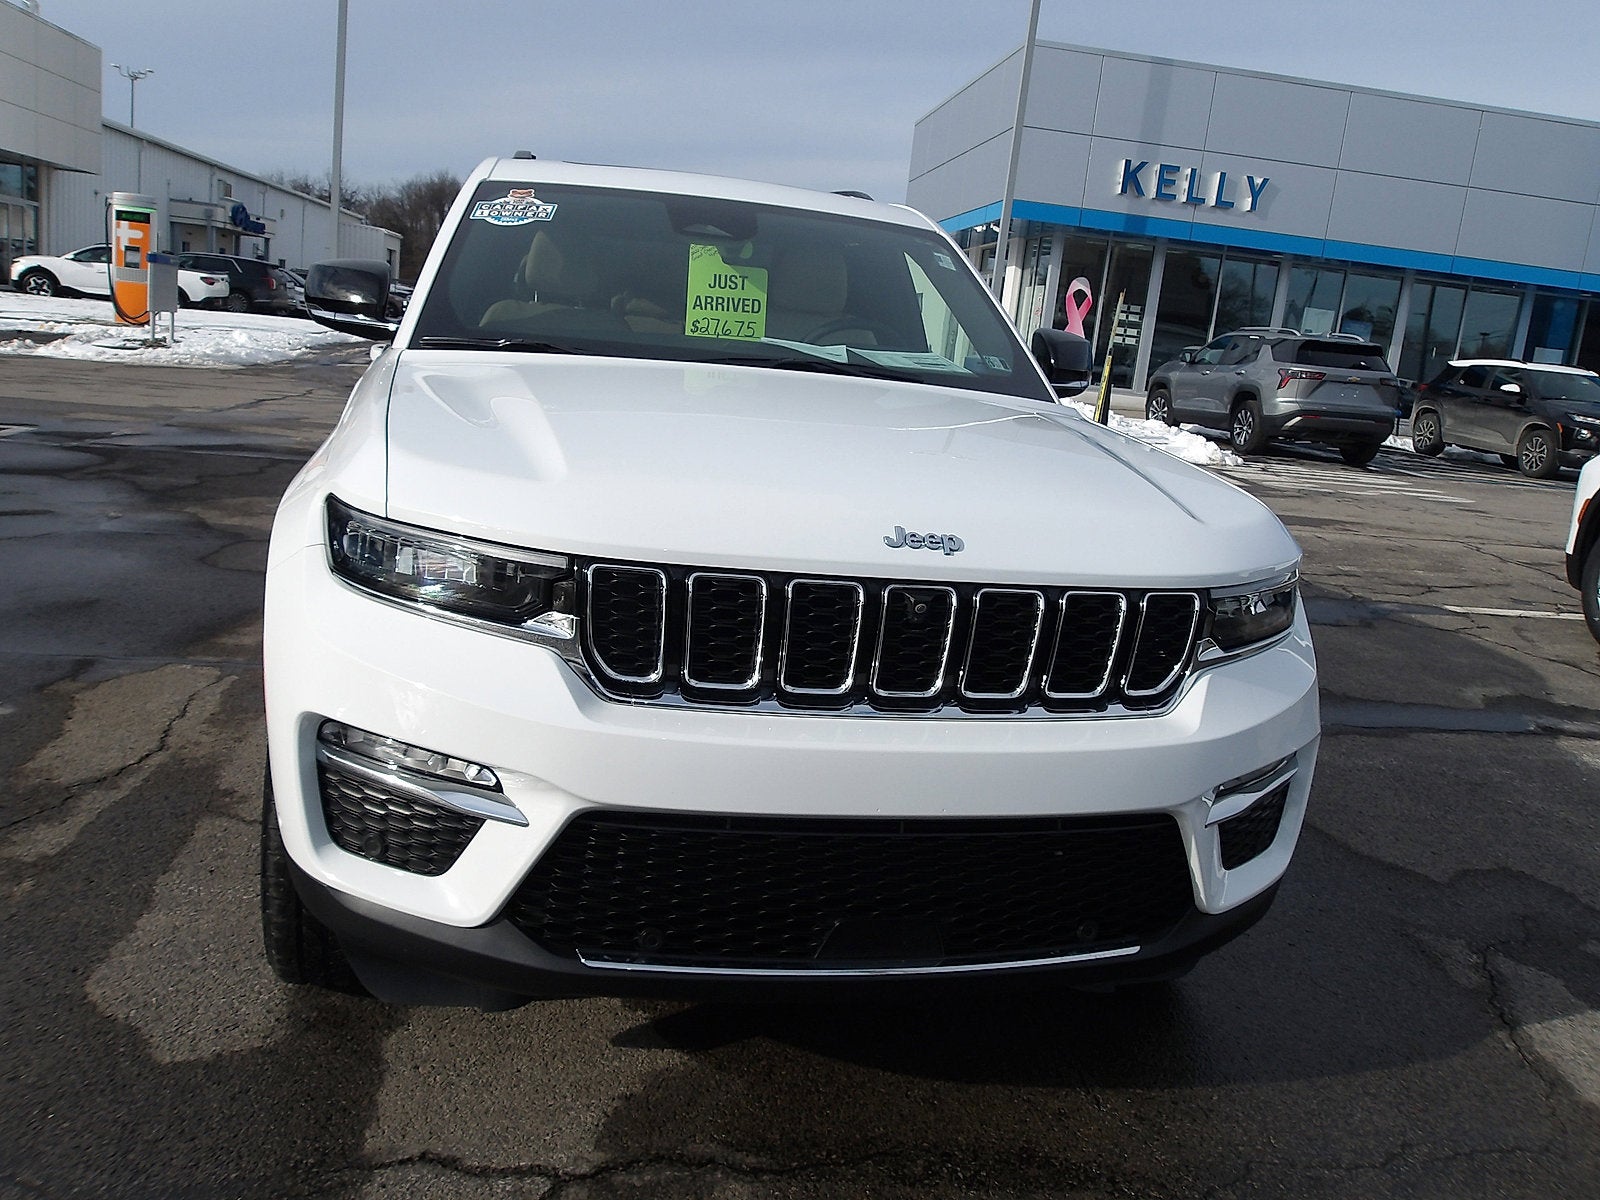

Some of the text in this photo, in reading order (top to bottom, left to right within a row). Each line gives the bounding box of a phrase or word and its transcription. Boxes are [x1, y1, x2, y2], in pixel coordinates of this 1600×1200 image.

[1118, 158, 1270, 212] KELLY
[481, 203, 550, 213] CARFAX
[489, 210, 548, 218] OWNER
[708, 273, 749, 291] JUST
[692, 295, 761, 314] ARRIVED
[883, 525, 965, 556] Jeep
